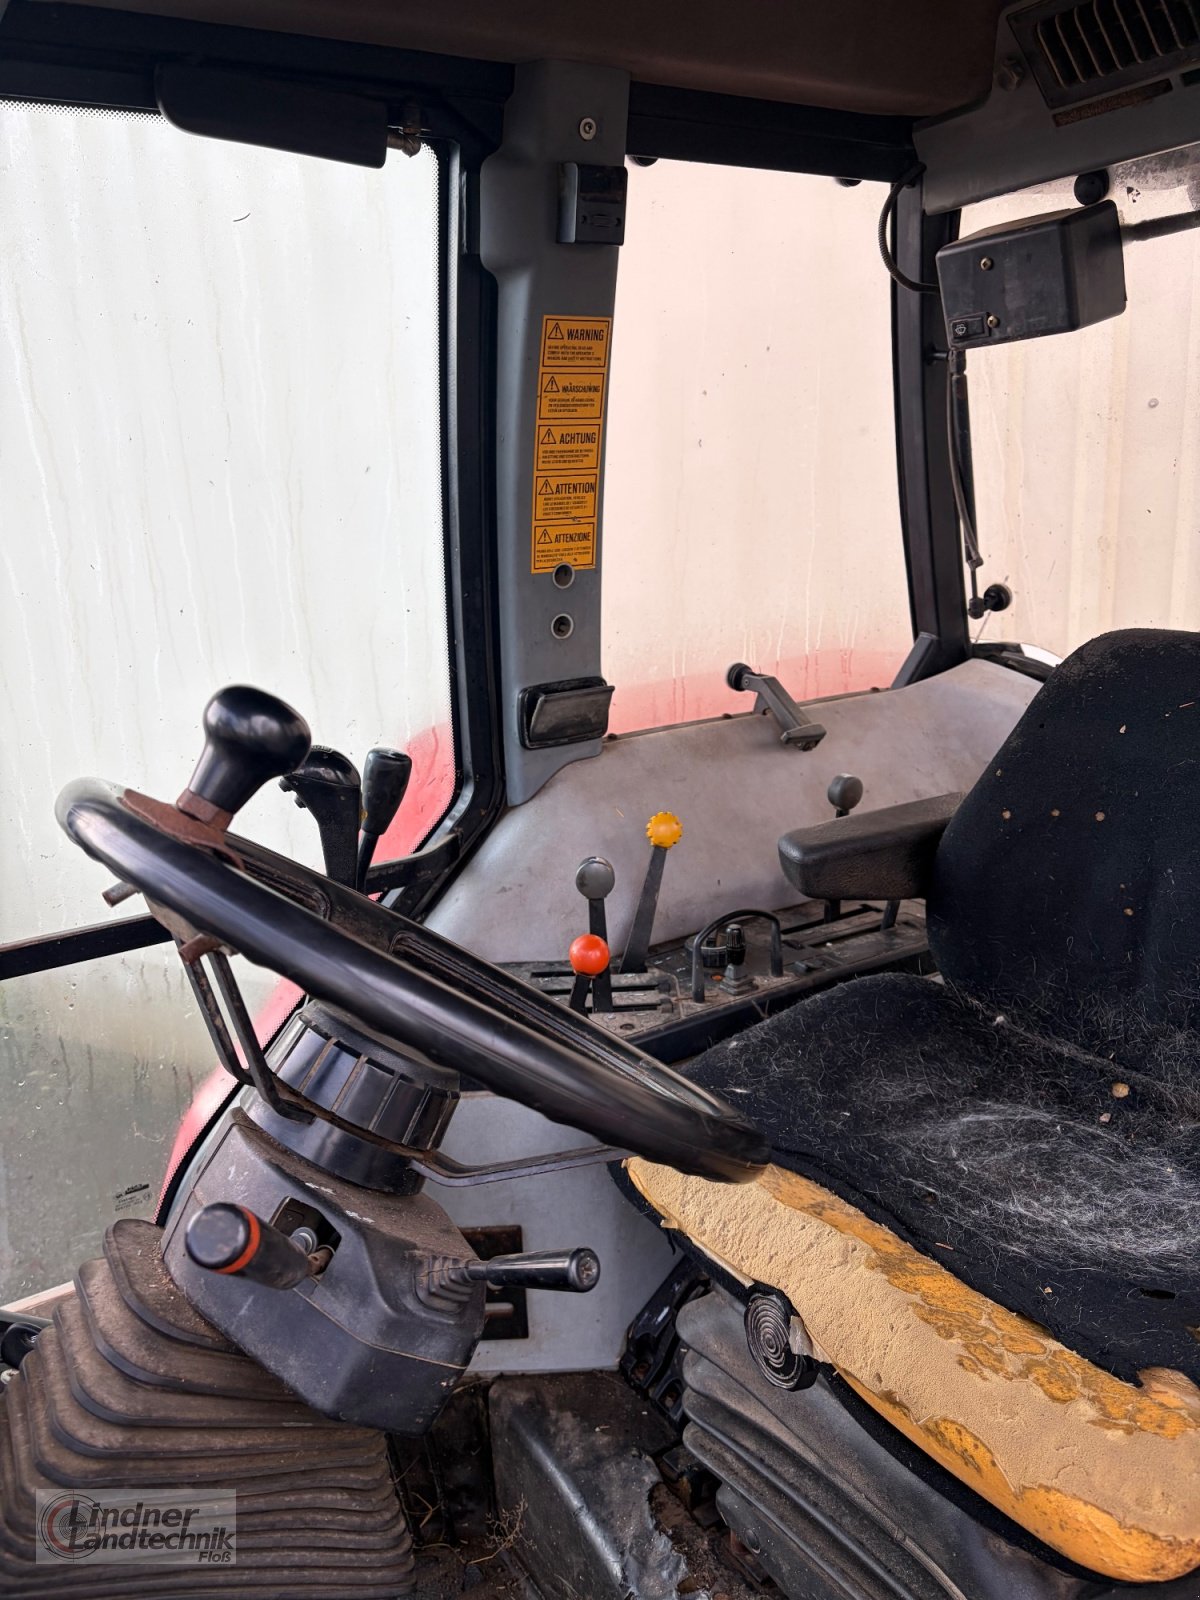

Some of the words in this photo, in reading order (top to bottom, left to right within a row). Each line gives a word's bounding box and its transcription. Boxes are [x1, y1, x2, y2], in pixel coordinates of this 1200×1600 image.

[567, 328, 605, 341] WARNING
[559, 432, 596, 444] ACHTUNG
[555, 482, 595, 495] ATTENTION
[555, 532, 591, 543] ATTENZIONE
